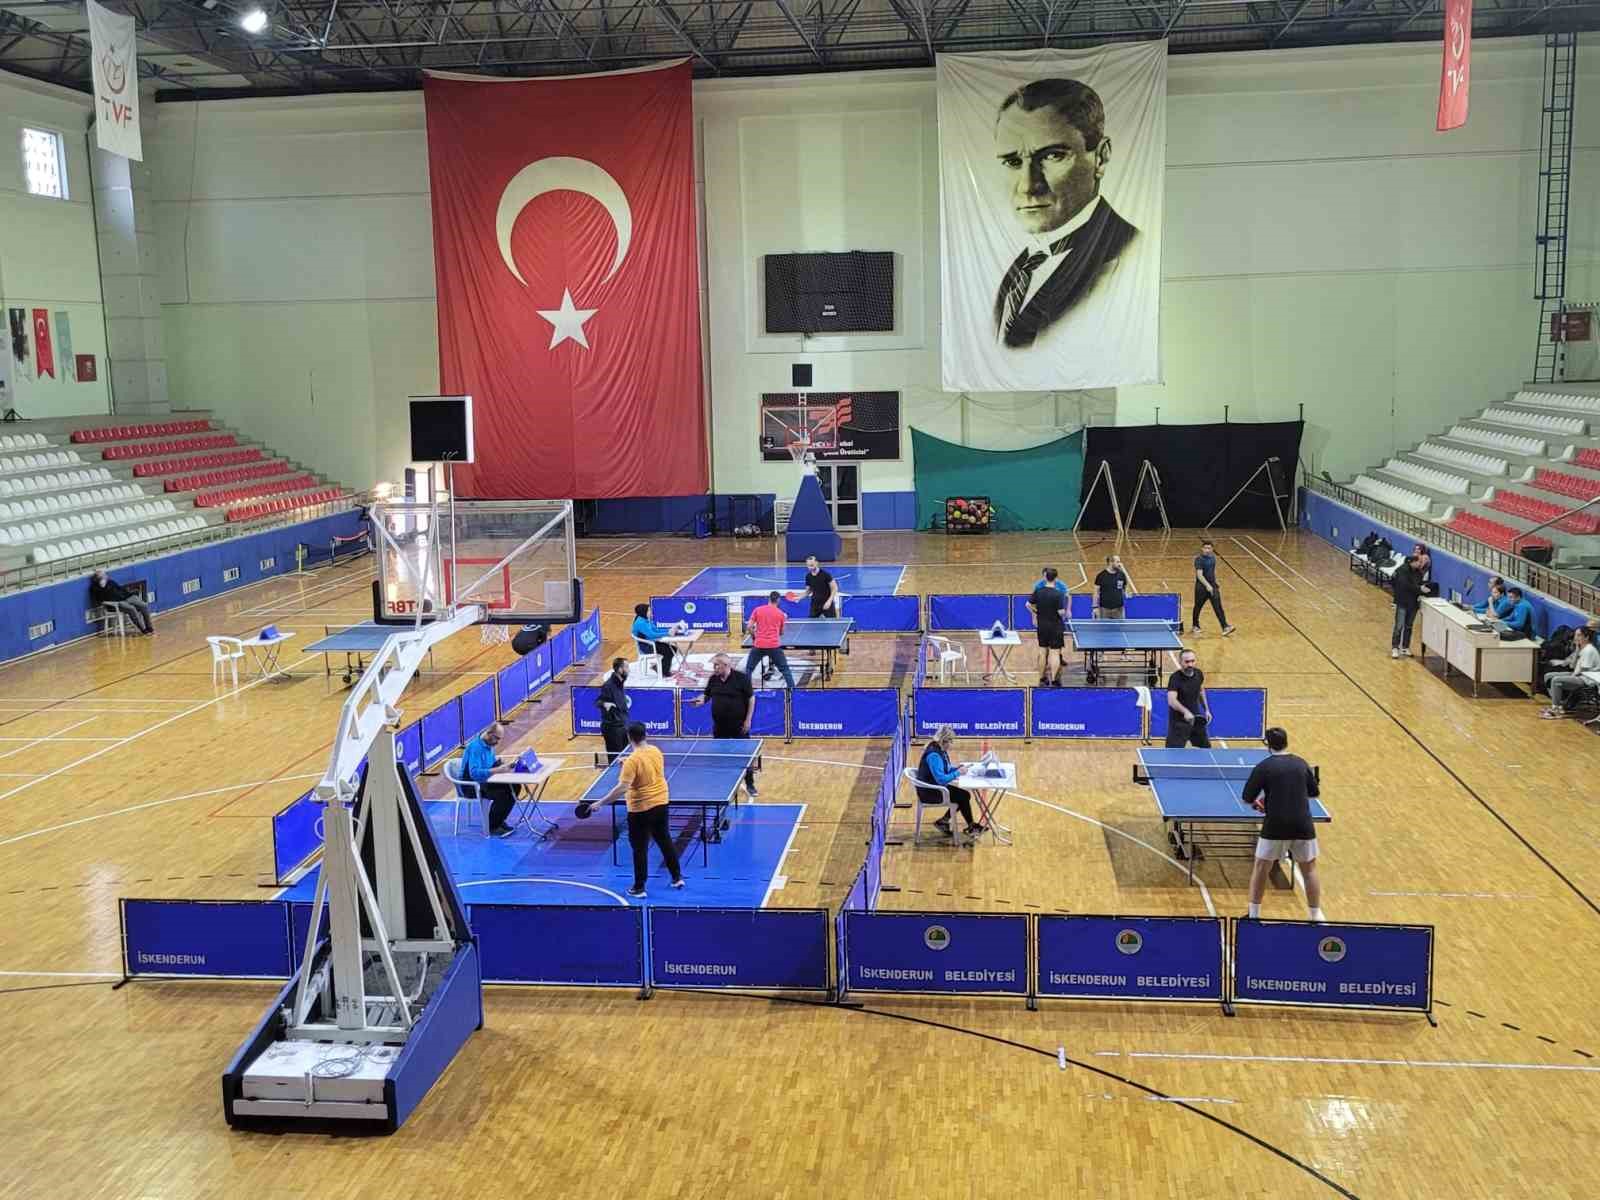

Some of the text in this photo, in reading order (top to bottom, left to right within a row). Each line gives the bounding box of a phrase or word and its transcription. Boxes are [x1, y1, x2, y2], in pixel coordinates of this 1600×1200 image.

[101, 96, 132, 128] TVF
[975, 721, 1018, 730] BELEDİYESİ
[137, 949, 206, 966] İSKENDERUN
[664, 960, 737, 976] İSKENDERUN
[859, 965, 1016, 983] İSKENDERUN BELEDİYESİ
[1049, 970, 1210, 988] İSKENDERUN BELEDİYESİ
[1246, 975, 1417, 996] İSKENDERUN BELEDİYESİ
